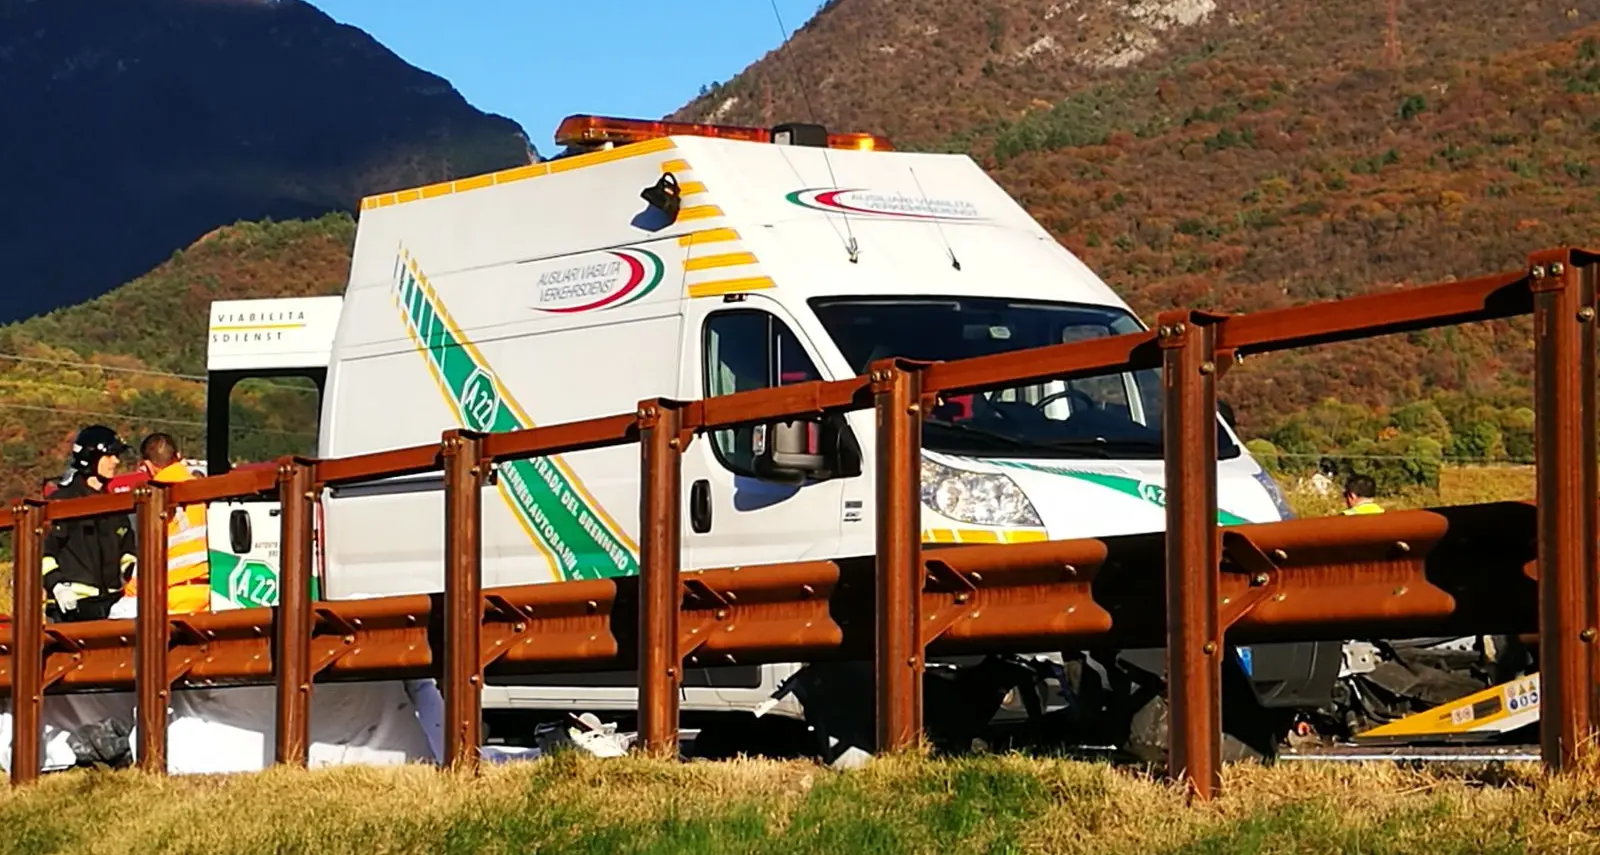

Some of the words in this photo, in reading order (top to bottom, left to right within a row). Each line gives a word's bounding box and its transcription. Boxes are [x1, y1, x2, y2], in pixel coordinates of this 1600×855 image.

[212, 331, 282, 343] SDIENST
[465, 380, 494, 431] A22
[501, 459, 578, 571] RENNERAUTOBAHN
[1146, 485, 1166, 504] A2
[561, 489, 579, 516] DEL
[578, 510, 629, 571] BRENNERO
[237, 568, 277, 607] A22
